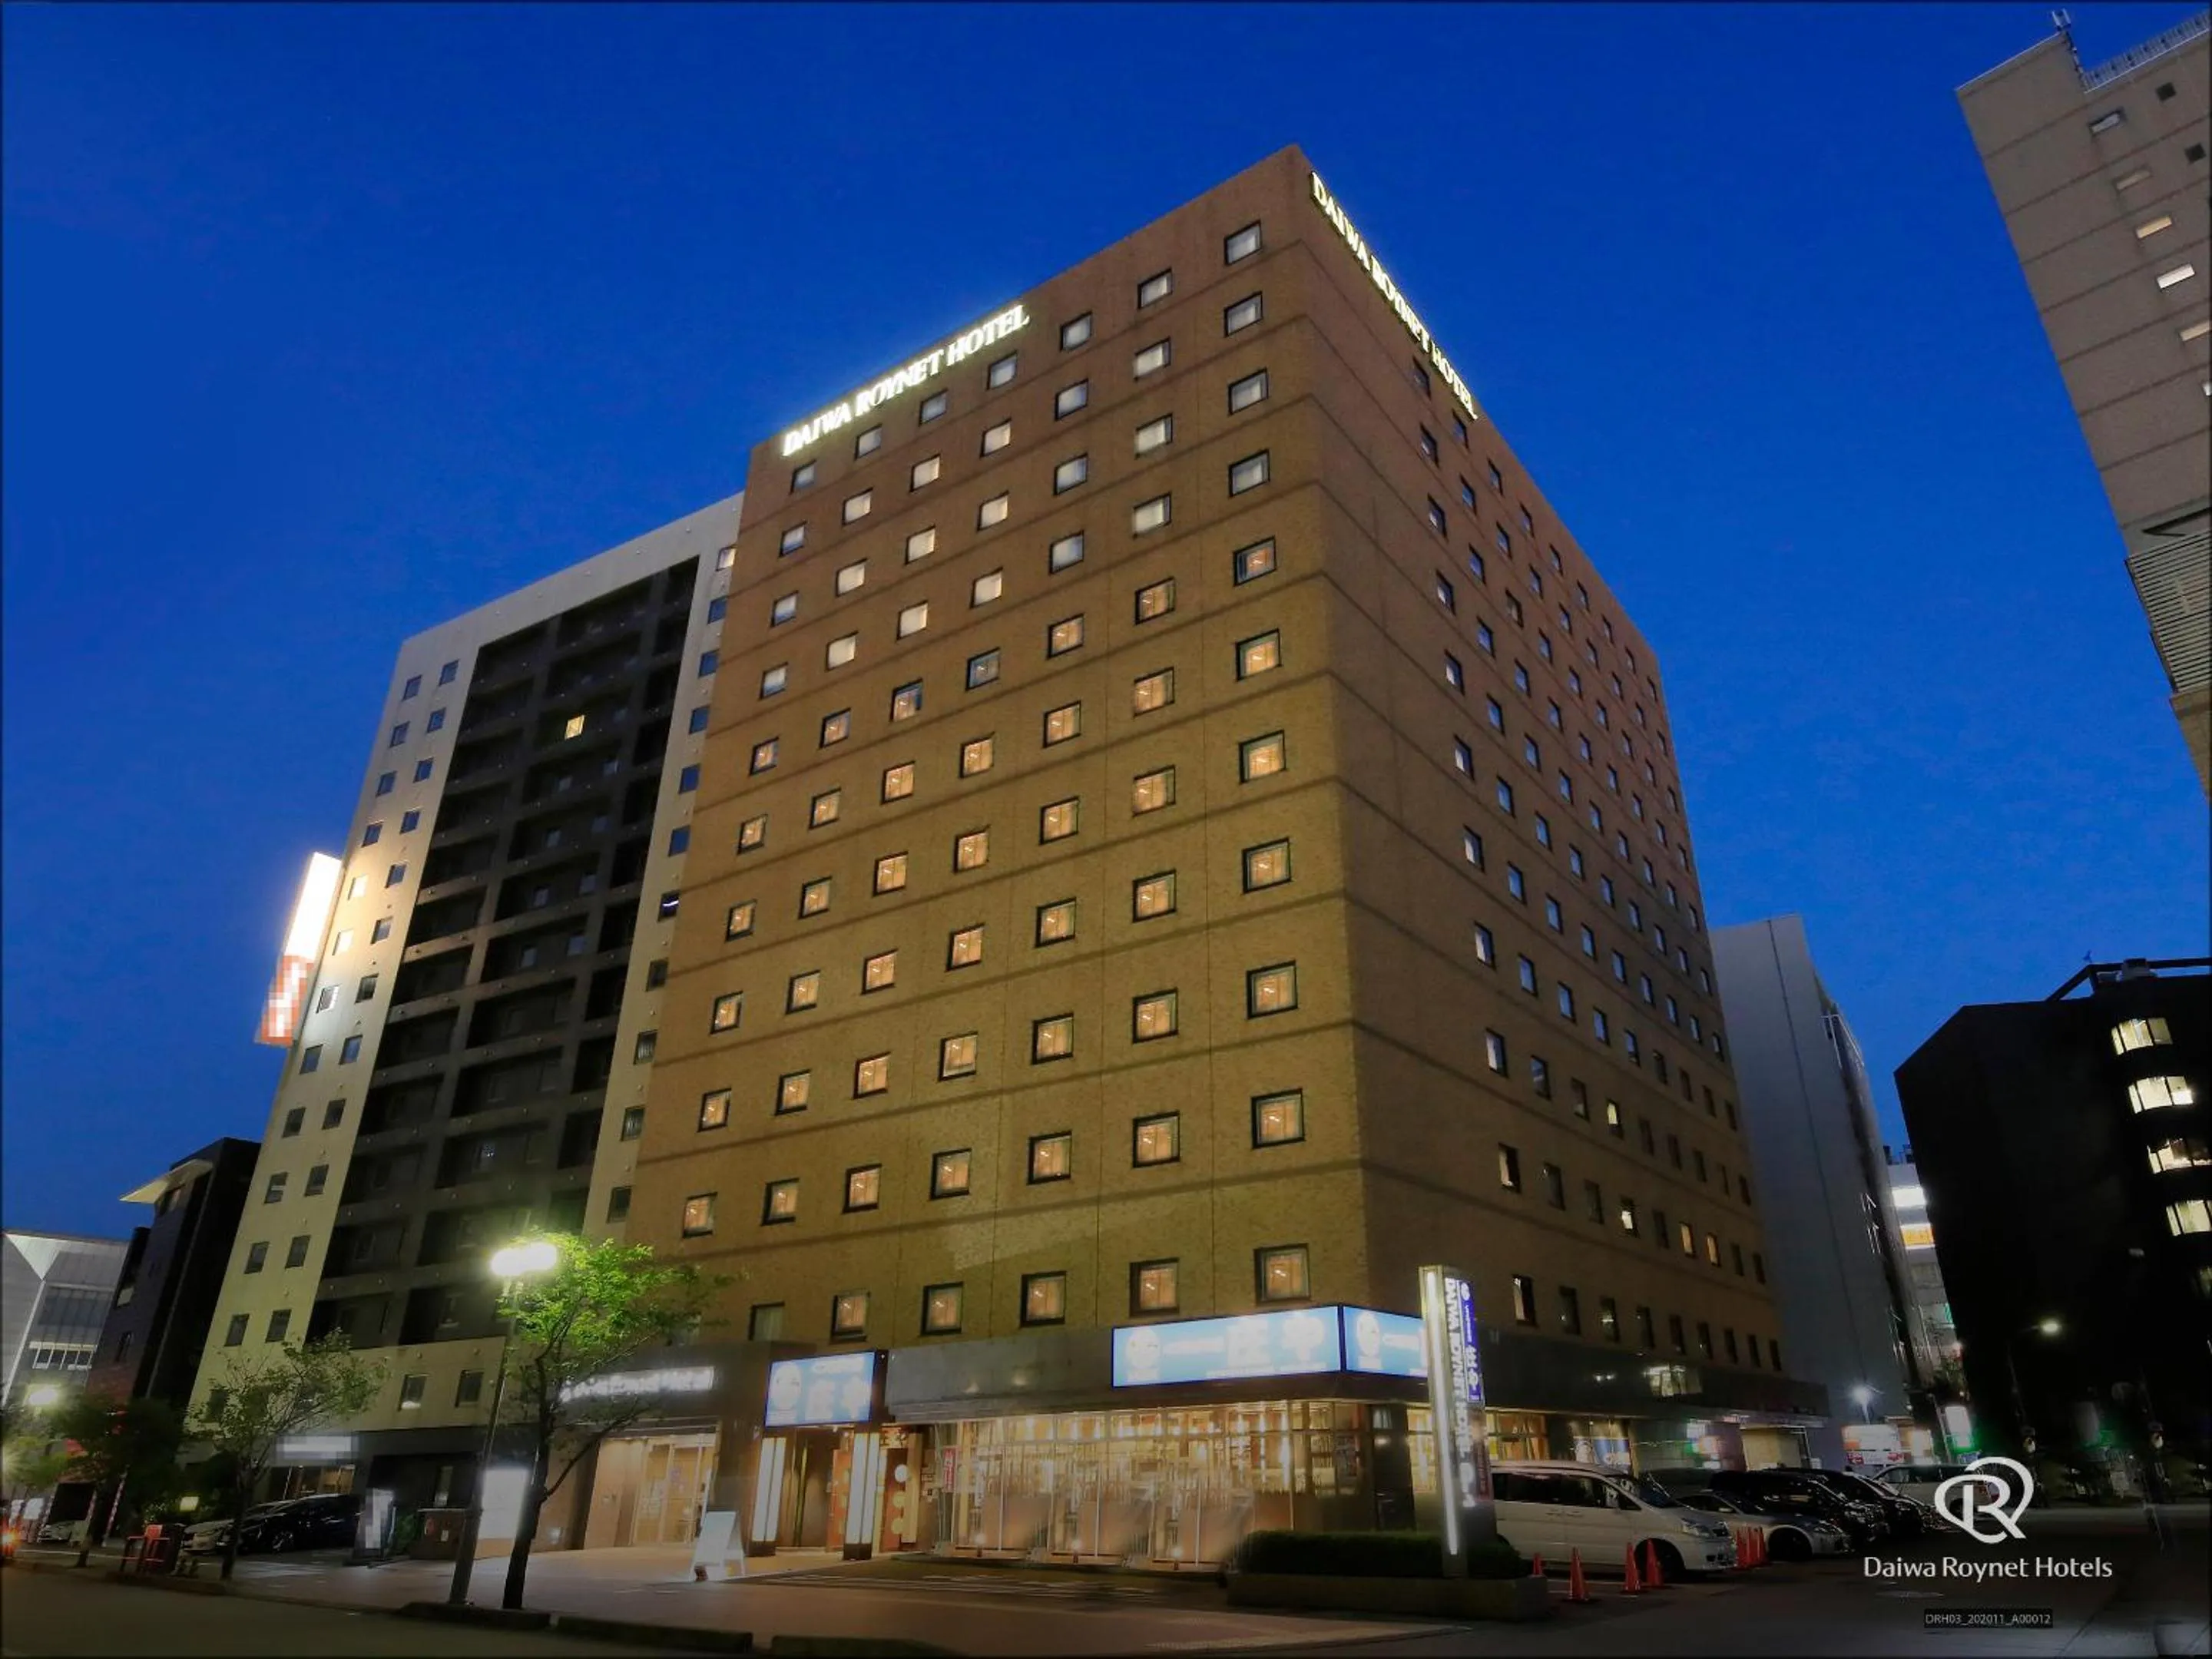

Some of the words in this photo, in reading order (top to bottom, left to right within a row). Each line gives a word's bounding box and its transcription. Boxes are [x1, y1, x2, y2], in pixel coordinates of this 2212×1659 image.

[1310, 171, 1371, 271] DAIWA
[782, 401, 852, 457] DAIWA
[945, 304, 1031, 367] HOTEL
